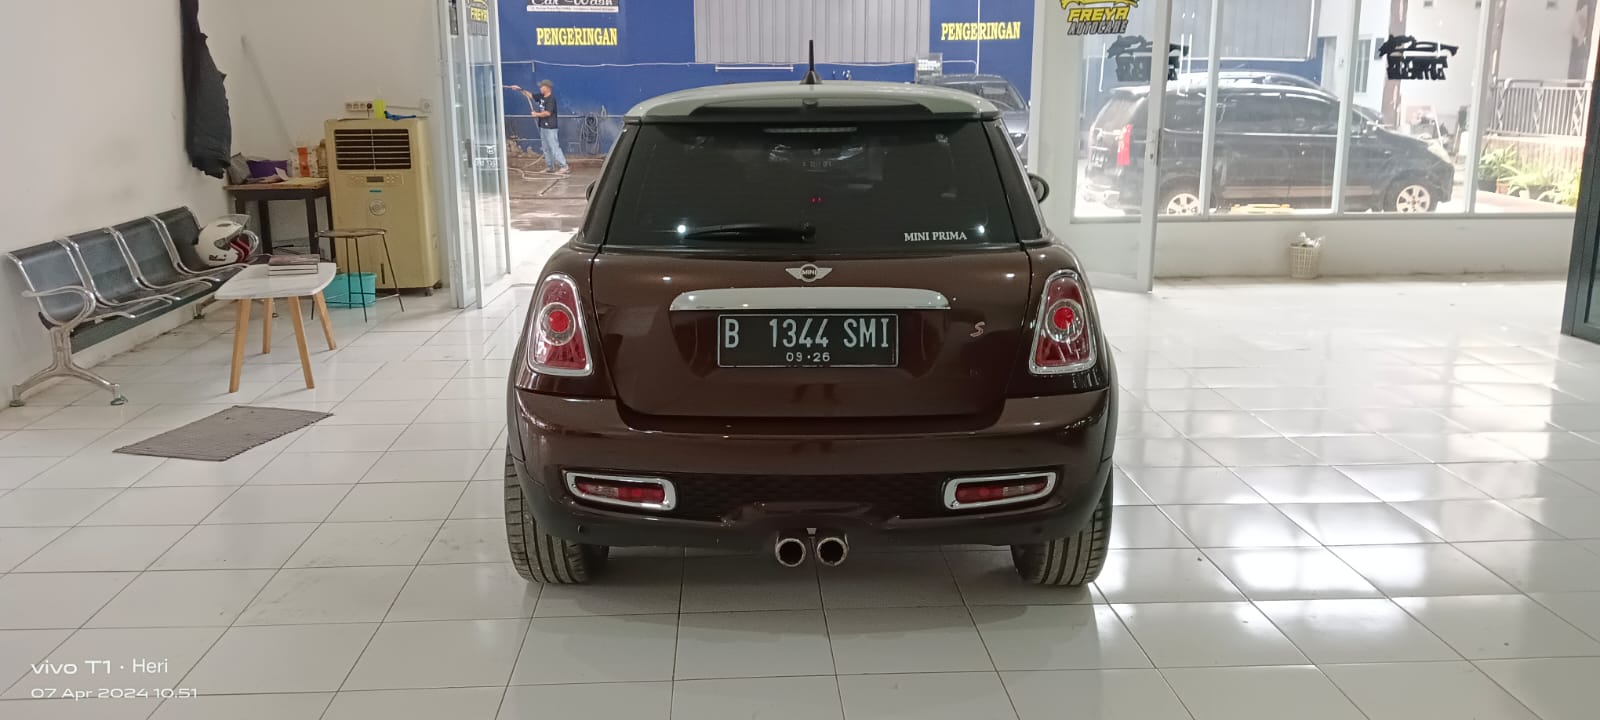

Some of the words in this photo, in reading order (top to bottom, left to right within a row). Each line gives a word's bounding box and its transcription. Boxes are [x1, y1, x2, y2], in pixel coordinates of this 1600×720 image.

[1067, 7, 1130, 22] FREYA
[536, 27, 618, 46] PENGERINGAN
[941, 21, 1021, 41] PENGERINGAN
[904, 232, 930, 242] MINI
[932, 231, 967, 241] PRIMA
[724, 318, 740, 349] B
[769, 318, 829, 348] 1344
[843, 318, 890, 348] SMI
[969, 321, 986, 338] S
